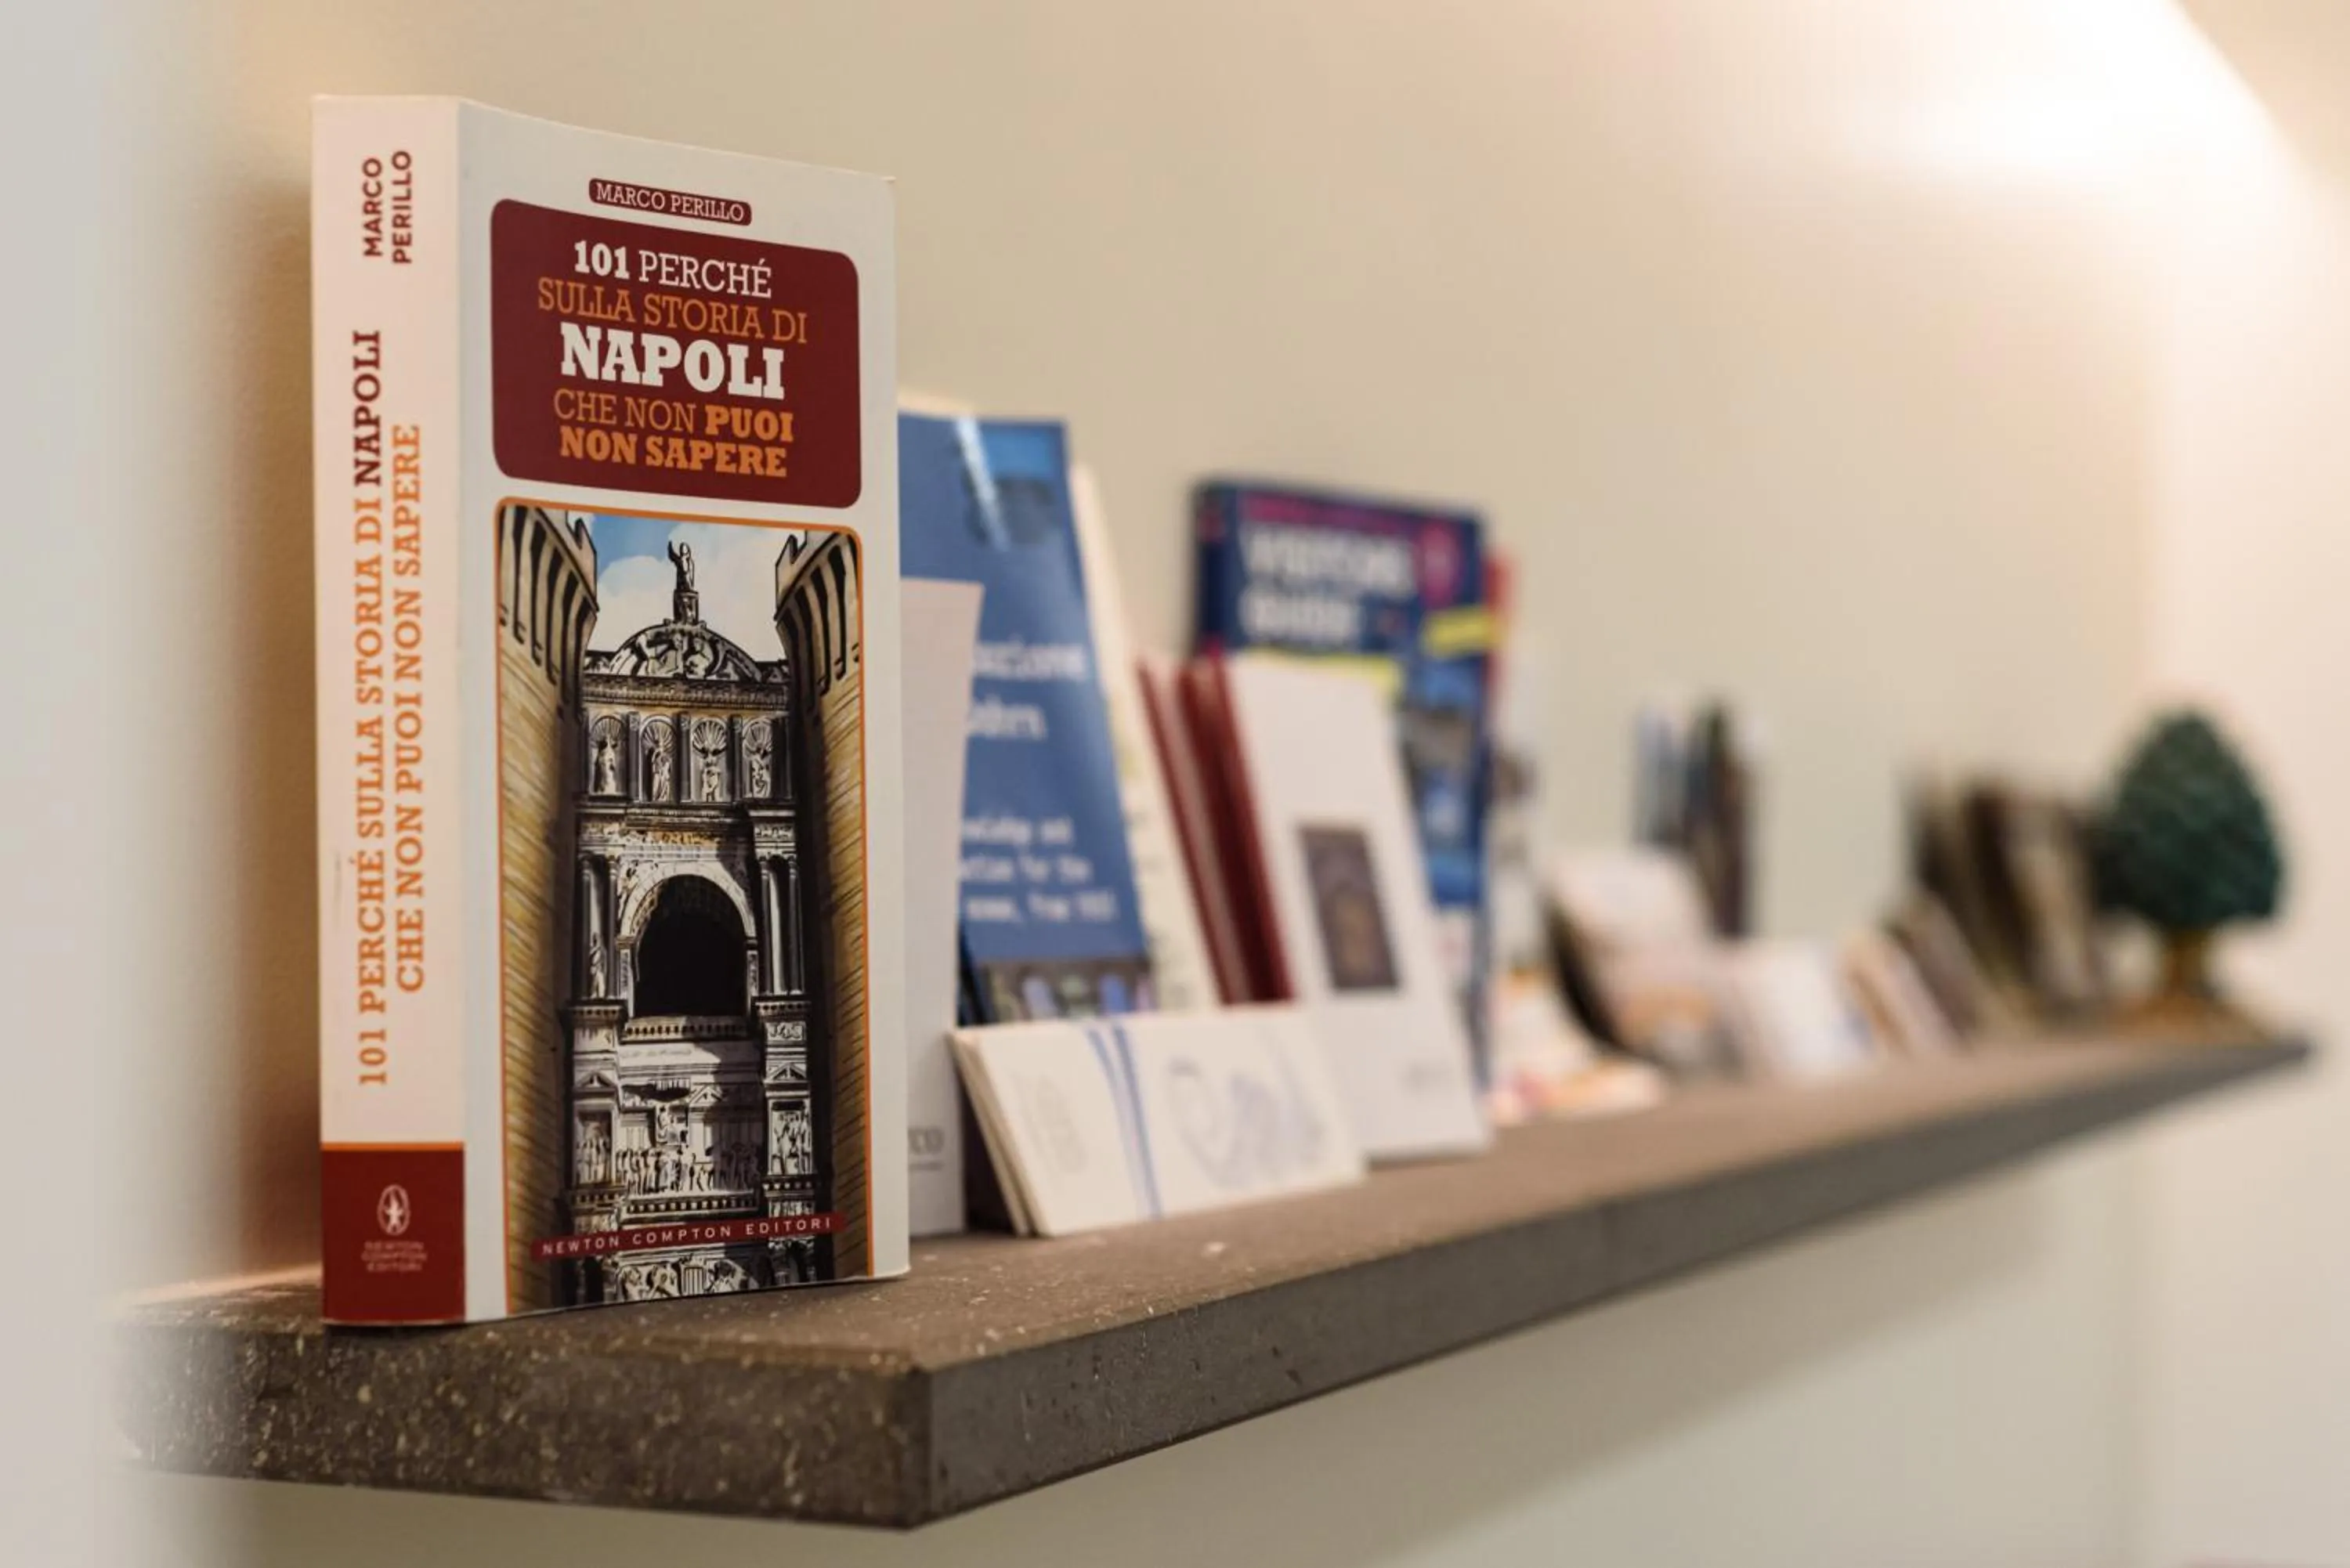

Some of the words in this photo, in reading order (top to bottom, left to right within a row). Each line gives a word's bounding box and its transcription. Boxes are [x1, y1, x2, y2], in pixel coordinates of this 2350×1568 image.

[362, 156, 383, 258] MARCO
[391, 150, 412, 265] PERILLO
[595, 182, 665, 211] MARCO
[671, 194, 744, 222] PERILLO
[537, 276, 634, 323] SULLA
[644, 292, 765, 341] STORIA
[772, 309, 808, 345] DI
[573, 240, 630, 280] 101
[638, 249, 772, 298] PERCHÉ
[560, 321, 785, 400] NAPOLI
[352, 331, 381, 487] NAPOLI
[553, 388, 618, 427] CHE
[626, 396, 697, 434] NON
[704, 404, 794, 443] PUOI
[560, 425, 637, 466] NON
[645, 436, 787, 478] SAPERE
[354, 497, 382, 545] DI
[392, 425, 421, 577] SAPERE
[355, 554, 384, 705] STORIA
[393, 589, 421, 681] NON
[356, 716, 385, 840] SULLA
[394, 692, 423, 793] PUOI
[395, 805, 424, 898] NON
[349, 850, 386, 1015] PERCHÉ
[396, 909, 425, 993] CHE
[359, 1029, 387, 1086] 101
[542, 1235, 621, 1255] NEWTON
[632, 1225, 733, 1245] COMPTON
[745, 1216, 833, 1235] EDITORI
